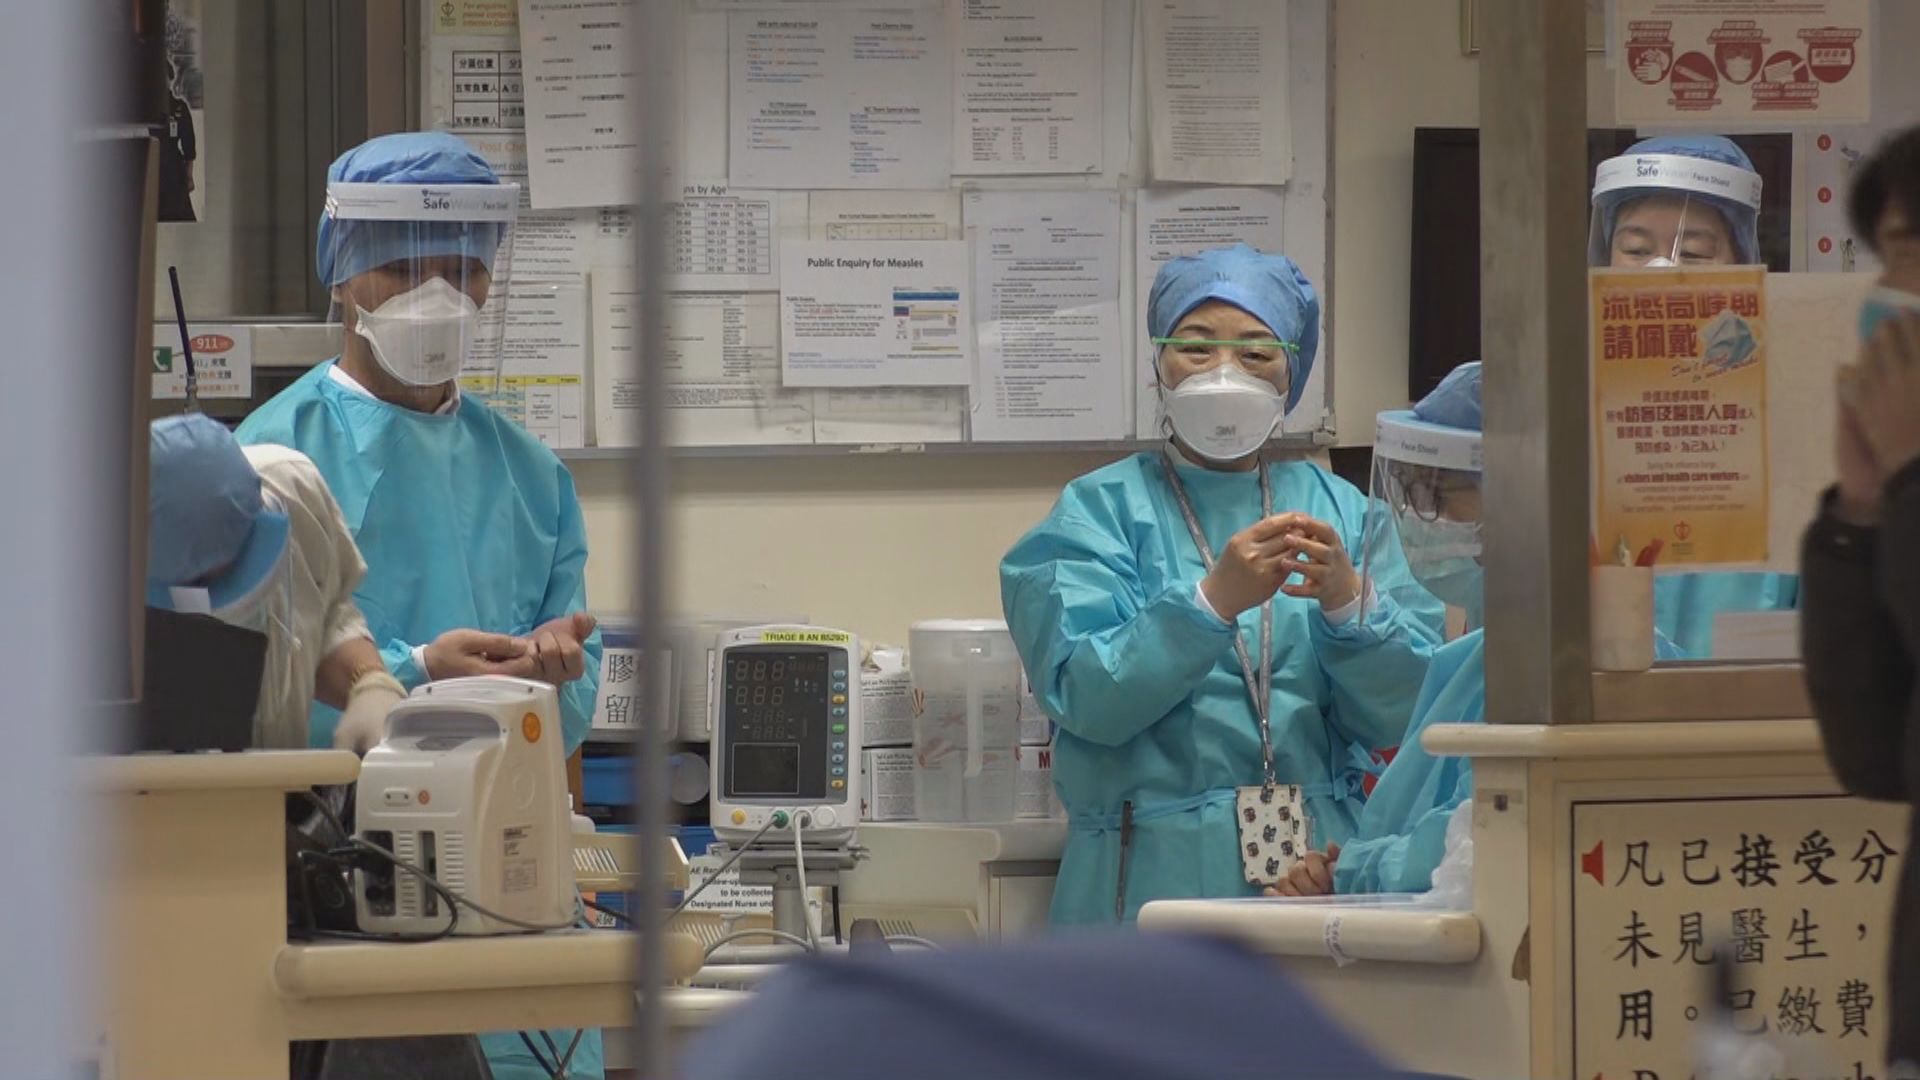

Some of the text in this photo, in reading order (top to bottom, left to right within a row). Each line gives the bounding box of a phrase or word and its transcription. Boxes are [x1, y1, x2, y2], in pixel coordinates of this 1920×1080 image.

[697, 185, 708, 194] by
[711, 185, 727, 195] Age
[807, 258, 924, 269] Public Enquiry for Measles
[197, 338, 218, 350] 911
[1603, 324, 1699, 360] 請佩戴
[1215, 424, 1237, 436] 3M
[1666, 472, 1690, 482] health
[1710, 472, 1740, 481] workers
[765, 632, 796, 642] TRIAGE
[1614, 829, 1898, 888] 凡已接受分
[720, 888, 774, 897] to be collecte
[690, 901, 733, 909] Designated
